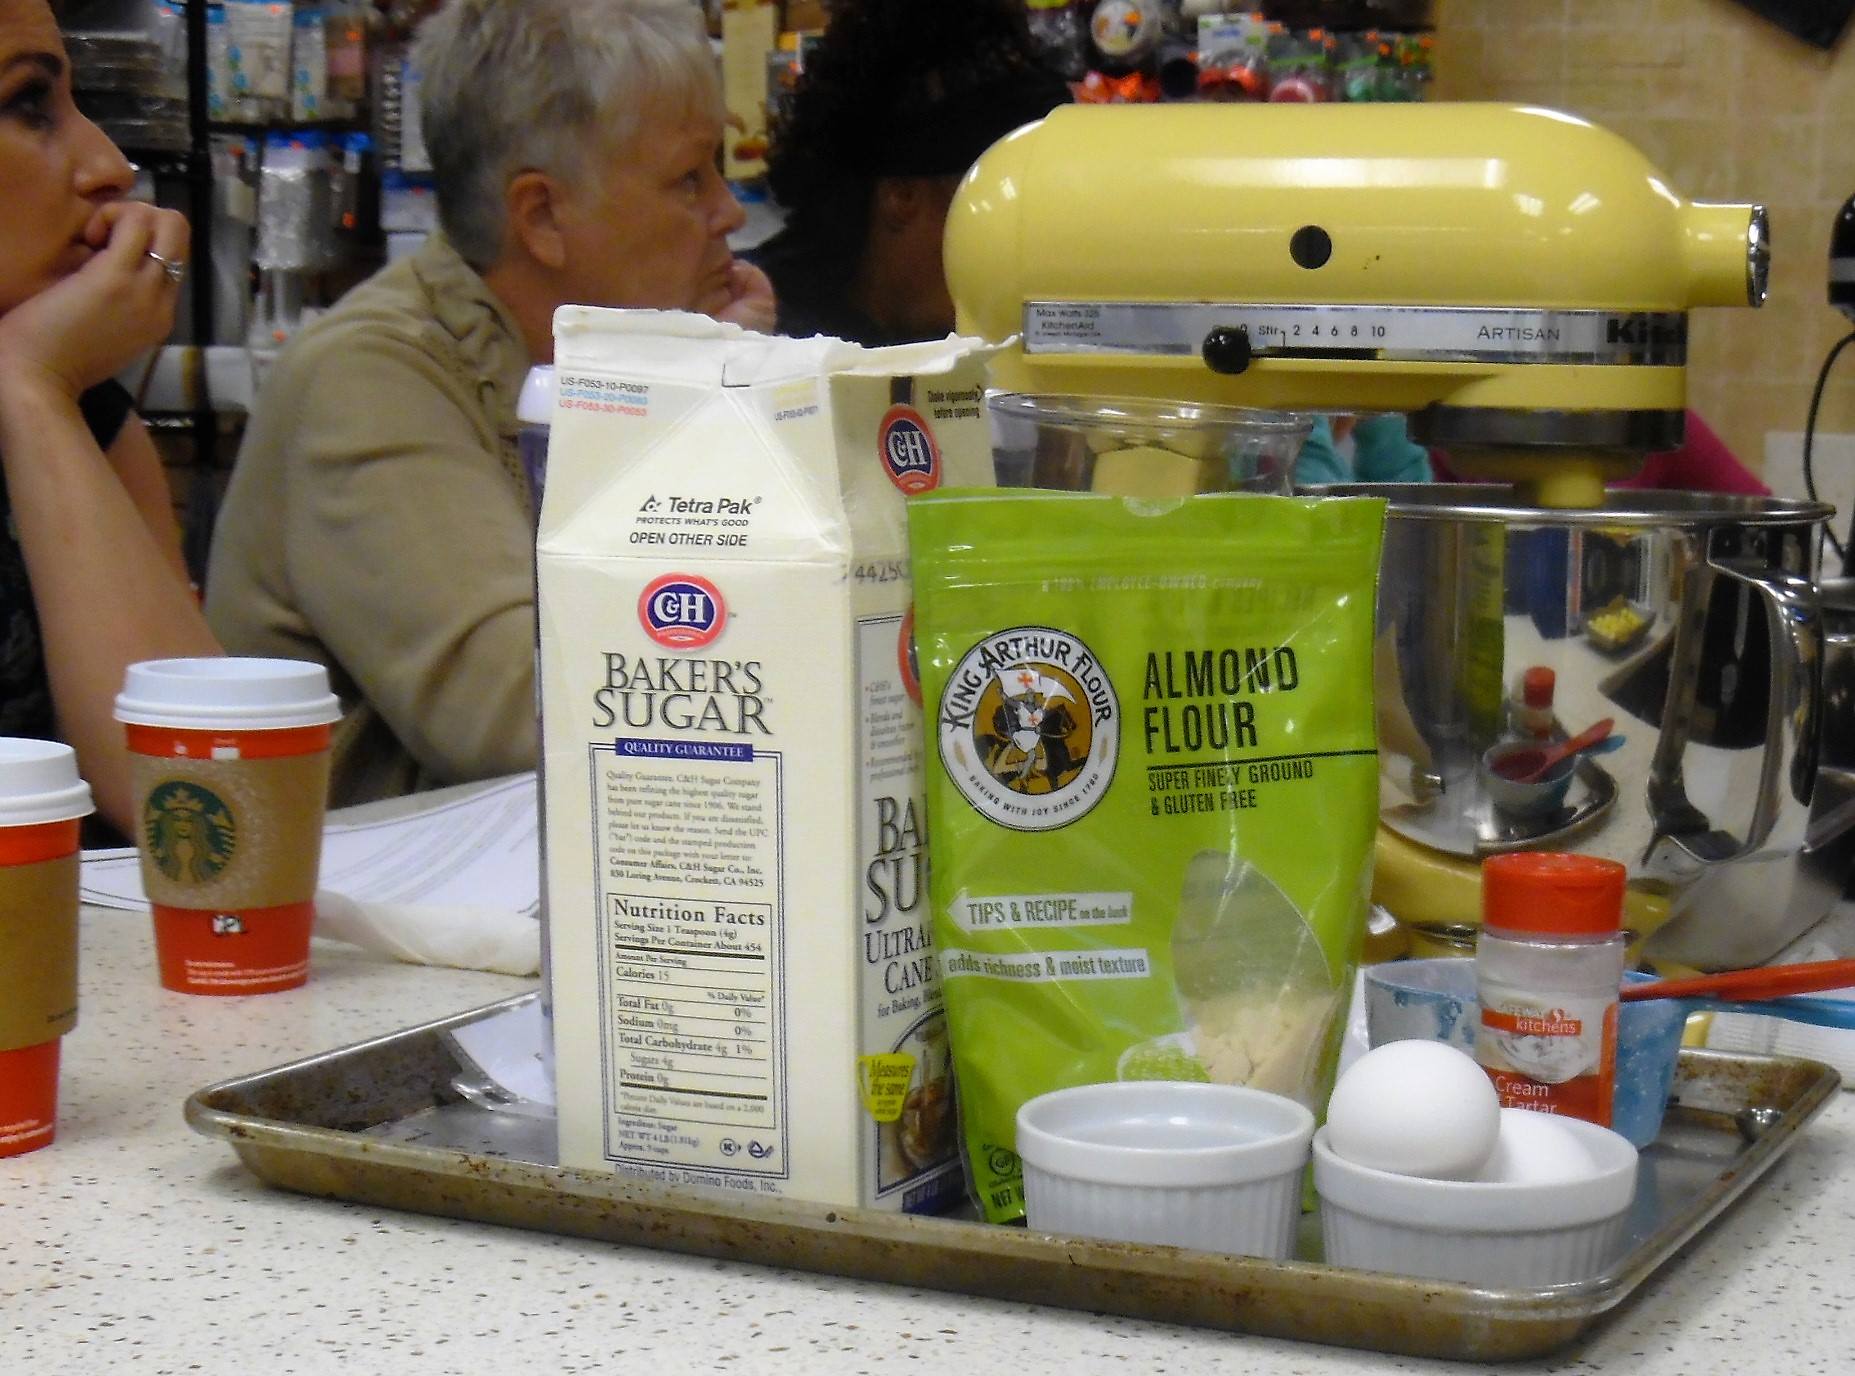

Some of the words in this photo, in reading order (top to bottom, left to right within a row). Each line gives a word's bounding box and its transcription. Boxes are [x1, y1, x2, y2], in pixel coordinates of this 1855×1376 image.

[1258, 325, 1278, 335] Stir
[1293, 325, 1300, 336] 2
[1312, 325, 1319, 336] 4
[1331, 326, 1338, 337] 6
[1351, 326, 1358, 337] 8
[1371, 326, 1385, 337] 10
[1476, 325, 1560, 341] ARTISAN
[888, 430, 927, 467] C&H
[669, 497, 714, 514] Tetra
[635, 517, 682, 525] PROTECTS
[685, 518, 719, 527] WHAT'S
[721, 519, 749, 527] GOOD
[629, 532, 665, 544] OPEN
[668, 533, 713, 546] OTHER
[717, 534, 748, 547] SIDE
[653, 592, 708, 624] C&H
[600, 651, 763, 695] BAKER'S
[1143, 646, 1299, 700] ALMOND
[943, 669, 983, 733] KING
[978, 636, 1071, 678] ARTHUR
[1071, 650, 1112, 727] FLOUR
[592, 688, 774, 735] SUGAR
[1143, 701, 1259, 754] FLOUR
[624, 741, 674, 755] QUALITY
[674, 744, 744, 758] GUARANTEE
[606, 770, 632, 780] Quality
[724, 776, 760, 788] Company
[1148, 769, 1189, 793] SUPER
[1249, 760, 1315, 785] GROUND
[620, 784, 637, 792] been
[669, 786, 680, 795] the
[683, 787, 708, 798] highest
[711, 788, 736, 799] quality
[968, 774, 999, 806] BAKING
[1002, 801, 1028, 816] WITH
[1031, 806, 1049, 816] JOY
[1053, 794, 1080, 814] SINCE
[1150, 798, 1160, 817] &
[1163, 794, 1214, 815] GLUTEN
[1219, 788, 1258, 810] FREE
[651, 823, 670, 832] know
[715, 826, 732, 835] Send
[735, 828, 747, 836] the
[749, 828, 768, 838] UPC
[654, 836, 666, 844] and
[668, 836, 680, 845] the
[610, 857, 647, 868] Consumer
[679, 863, 700, 871] C&H
[703, 864, 725, 874] Sugar
[724, 877, 736, 886] CA
[739, 878, 764, 887] 94525
[615, 898, 705, 922] Nutrition
[714, 906, 764, 925] Facts
[966, 902, 1005, 925] TIPS
[1010, 901, 1021, 922] &
[1025, 898, 1078, 922] RECIPE
[1107, 905, 1128, 919] back
[615, 921, 645, 932] Serving
[647, 924, 664, 933] Size
[675, 926, 716, 938] Teaspoon
[615, 933, 649, 944] Servings
[651, 935, 665, 945] Per
[668, 938, 711, 949] Container
[714, 941, 742, 950] About
[616, 952, 643, 961] Amount
[646, 954, 657, 962] Per
[659, 956, 687, 967] Serving
[949, 955, 981, 973] adds
[984, 958, 1041, 978] richness
[1046, 956, 1056, 977] &
[1059, 957, 1097, 976] moist
[1098, 956, 1146, 975] texture
[616, 966, 654, 980] Calories
[659, 970, 669, 981] 15
[618, 997, 641, 1009] Total
[644, 999, 658, 1010] Fat
[717, 992, 738, 1002] Daily
[617, 1015, 654, 1028] Sodium
[1516, 1015, 1576, 1034] kitchens
[618, 1033, 642, 1045] Total
[645, 1035, 712, 1053] Carbohydrate
[630, 1053, 659, 1065] Sugars
[620, 1068, 654, 1082] Protein
[1494, 1075, 1549, 1098] Cream
[1505, 1096, 1558, 1115] Tartar
[615, 1163, 665, 1181] Distributed
[669, 1171, 680, 1182] by
[683, 1172, 721, 1187] Domino
[725, 1176, 757, 1192] Foods,
